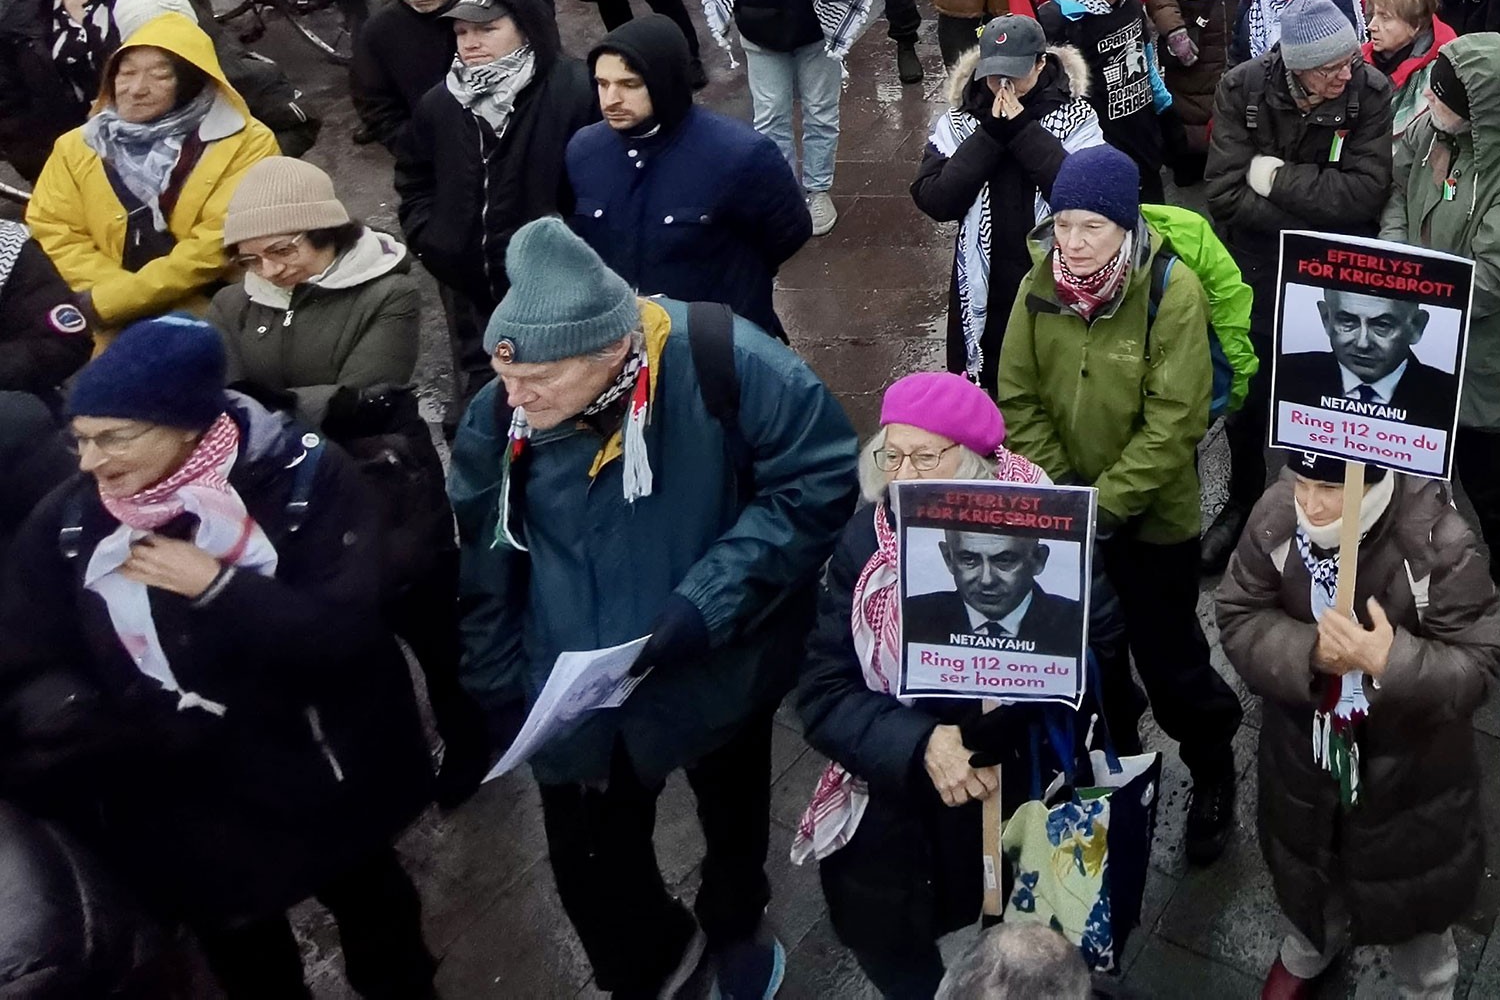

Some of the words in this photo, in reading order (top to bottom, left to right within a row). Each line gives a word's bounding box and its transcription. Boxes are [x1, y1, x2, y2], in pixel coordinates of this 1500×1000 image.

[1328, 250, 1423, 276] EFTERLYST
[1298, 258, 1334, 279] FÖR
[1339, 268, 1455, 297] KRIGSBROTT
[1320, 395, 1406, 421] NETANYAHU
[1291, 410, 1335, 434] Ring
[1341, 421, 1370, 438] 112
[1376, 431, 1407, 446] om
[1412, 434, 1438, 452] du
[1309, 432, 1337, 446] ser
[1344, 436, 1412, 463] honom
[944, 492, 1041, 512] EFTERLYST
[916, 506, 953, 521] FÖR
[958, 508, 1073, 531] KRIGSBROTT
[950, 633, 1036, 652] NETANYAHU
[920, 651, 965, 672] Ring
[972, 656, 1001, 670] 112
[1007, 663, 1038, 674] om
[1043, 661, 1069, 676] du
[940, 673, 970, 684] ser
[975, 671, 1045, 689] honom
